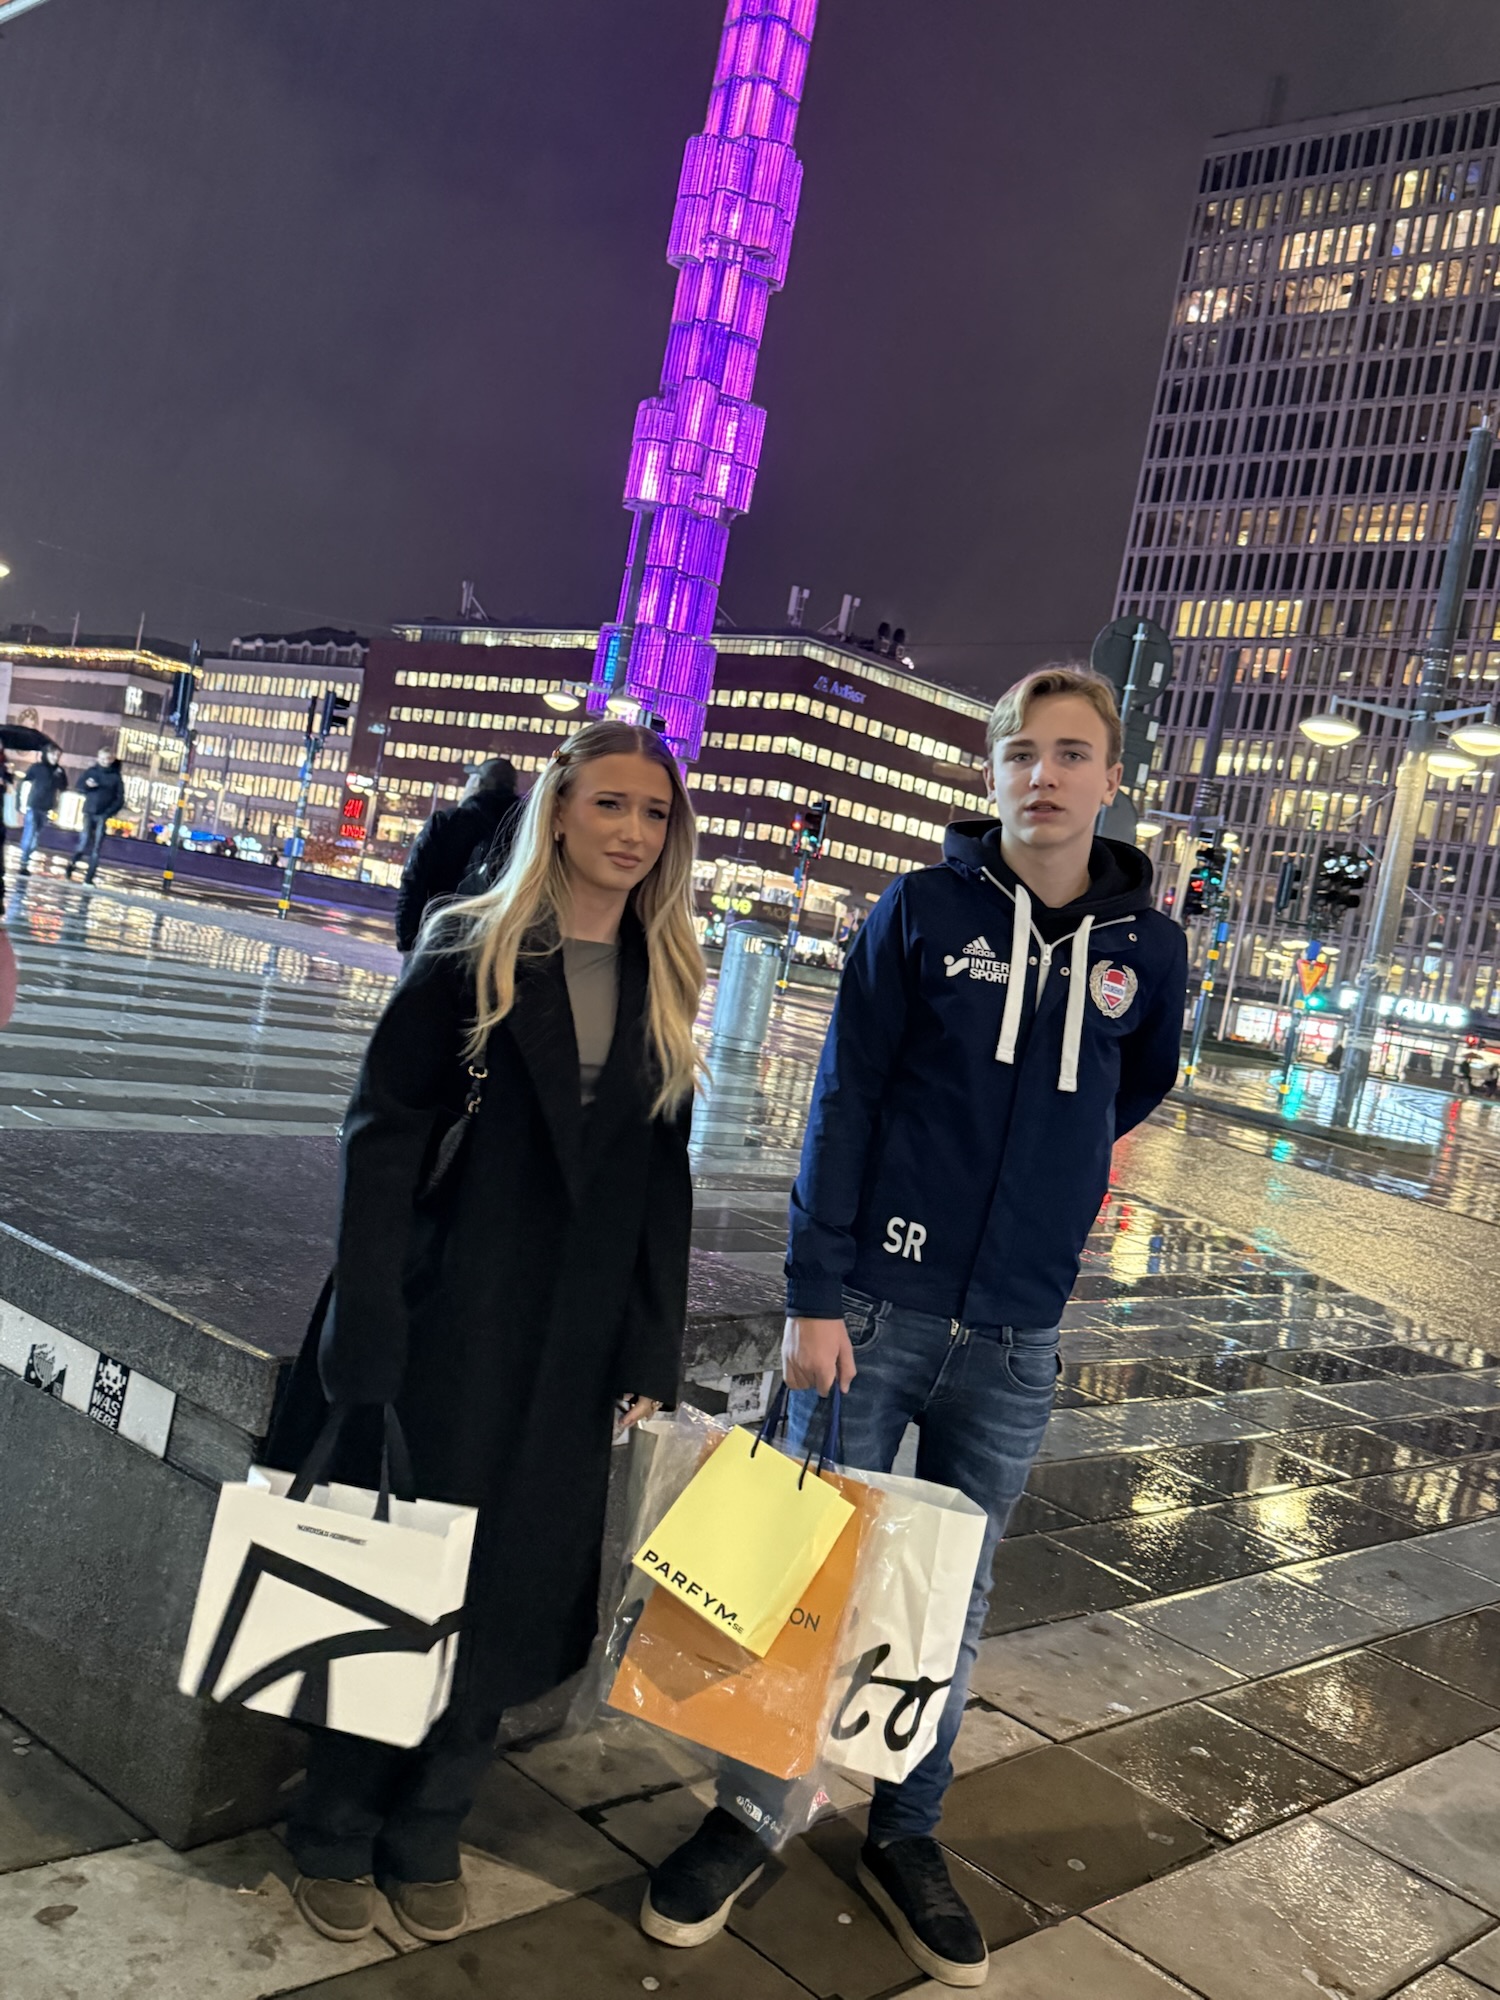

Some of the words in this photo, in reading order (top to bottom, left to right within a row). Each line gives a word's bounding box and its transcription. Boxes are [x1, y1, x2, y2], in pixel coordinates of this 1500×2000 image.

[962, 946, 996, 959] adidas
[968, 967, 1010, 985] SPORT
[970, 957, 1010, 975] INTER
[1338, 987, 1397, 1016] FE
[1395, 997, 1469, 1028] GUYS
[882, 1216, 927, 1263] SR
[91, 1389, 121, 1417] WAS
[89, 1405, 118, 1431] HERE
